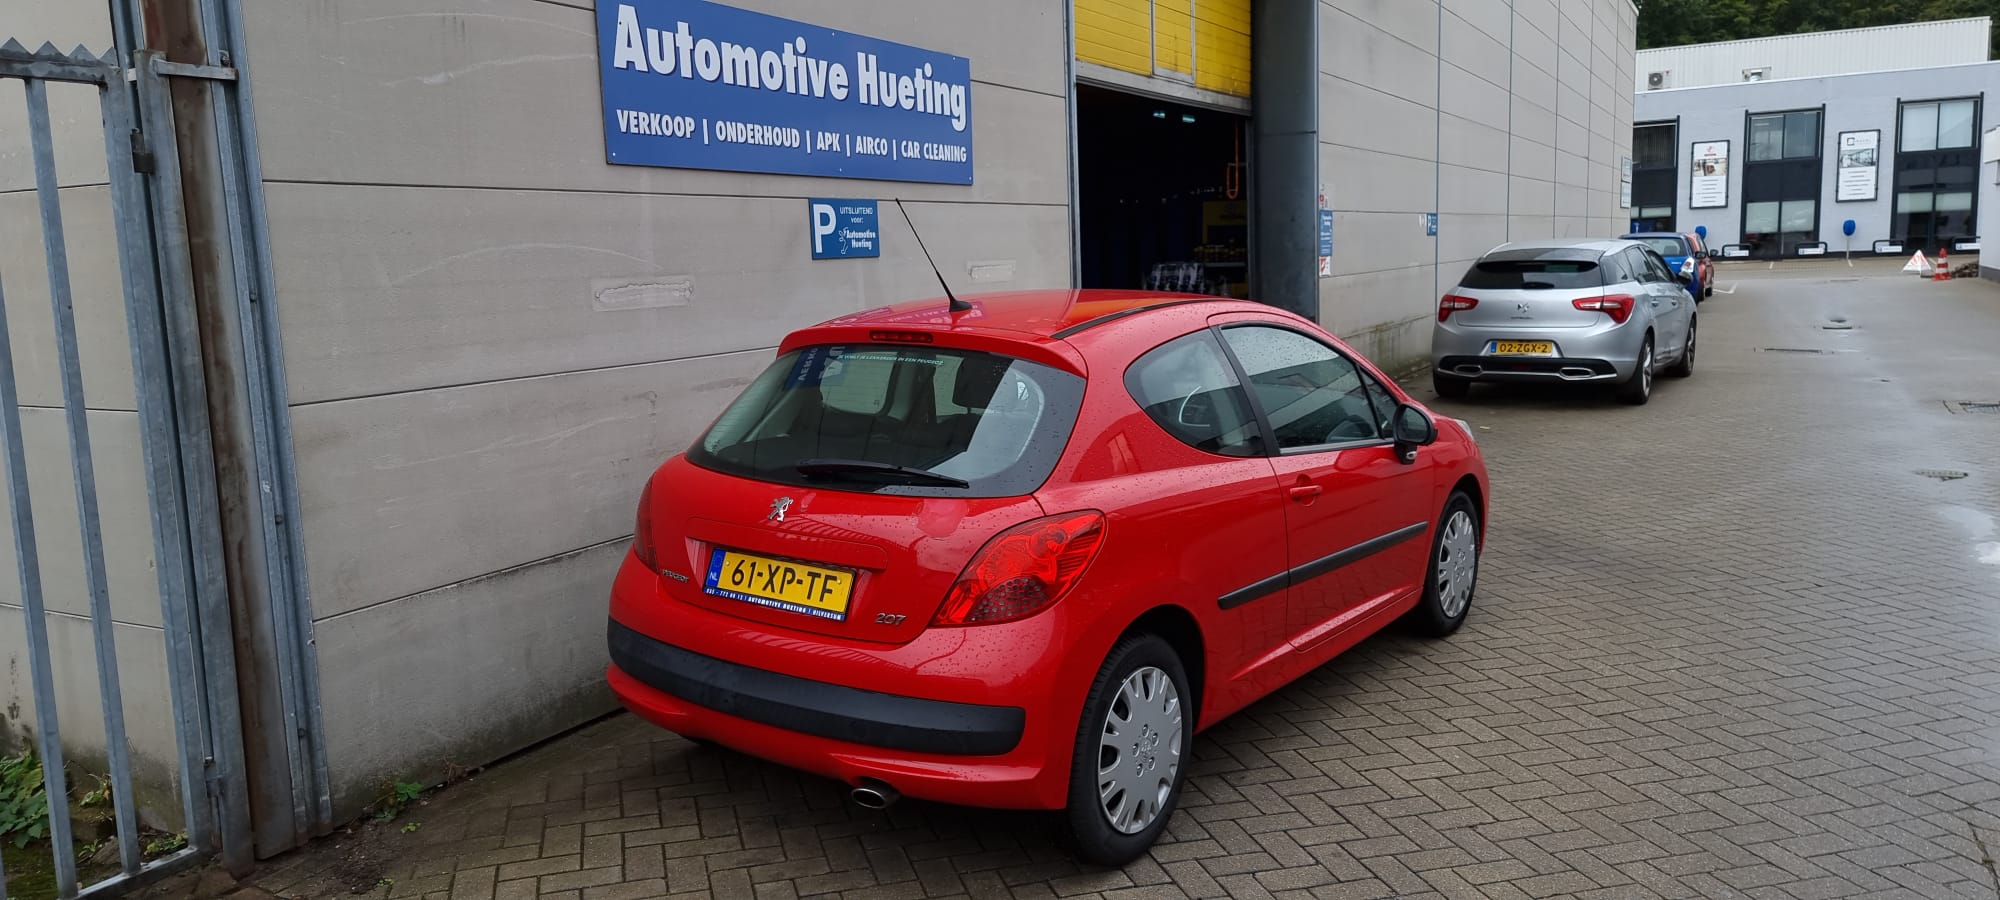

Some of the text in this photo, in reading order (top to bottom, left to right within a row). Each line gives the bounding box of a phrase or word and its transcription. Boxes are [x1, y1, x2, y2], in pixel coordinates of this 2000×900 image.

[613, 3, 967, 132] Automotive Hueting
[616, 109, 696, 139] VERKOOP
[715, 121, 801, 149] ONDERHOUD
[816, 131, 841, 153] APK
[855, 137, 888, 156] AIRCO
[901, 140, 921, 160] CAR
[923, 142, 967, 163] CLEANING
[839, 206, 873, 215] UITSLUITEND
[813, 203, 837, 254] P
[846, 229, 876, 239] Automotive
[851, 239, 872, 250] Hueting
[709, 571, 719, 582] NL
[731, 558, 838, 604] 61-XP-TF
[748, 595, 782, 609] AUTOMOTIVE
[875, 612, 907, 627] 207
